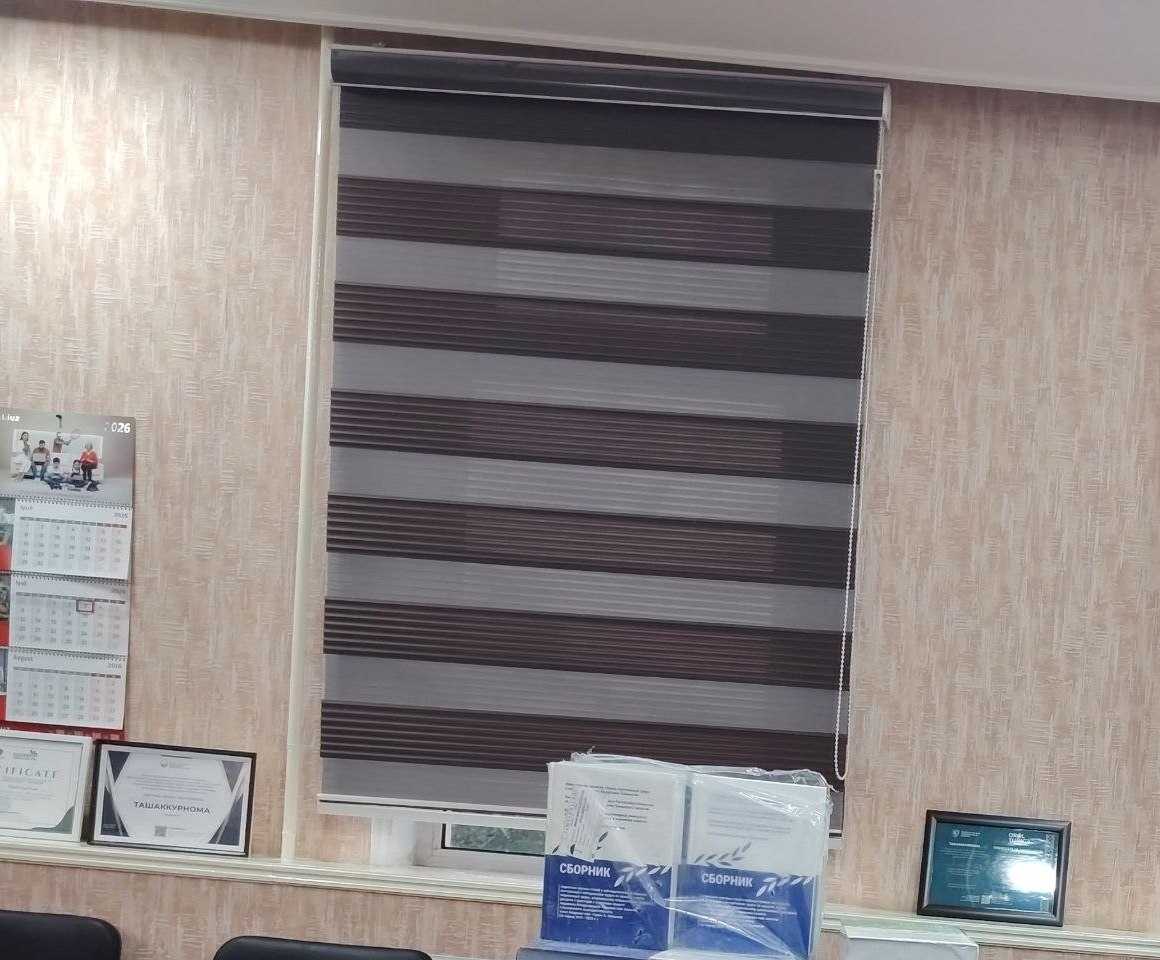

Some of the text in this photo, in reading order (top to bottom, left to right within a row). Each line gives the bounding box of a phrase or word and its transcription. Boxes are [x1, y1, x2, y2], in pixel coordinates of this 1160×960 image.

[134, 801, 211, 814] ТАШАККУРНОМА
[559, 862, 611, 878] СБОРНИК
[701, 873, 753, 888] СБОРНИК
